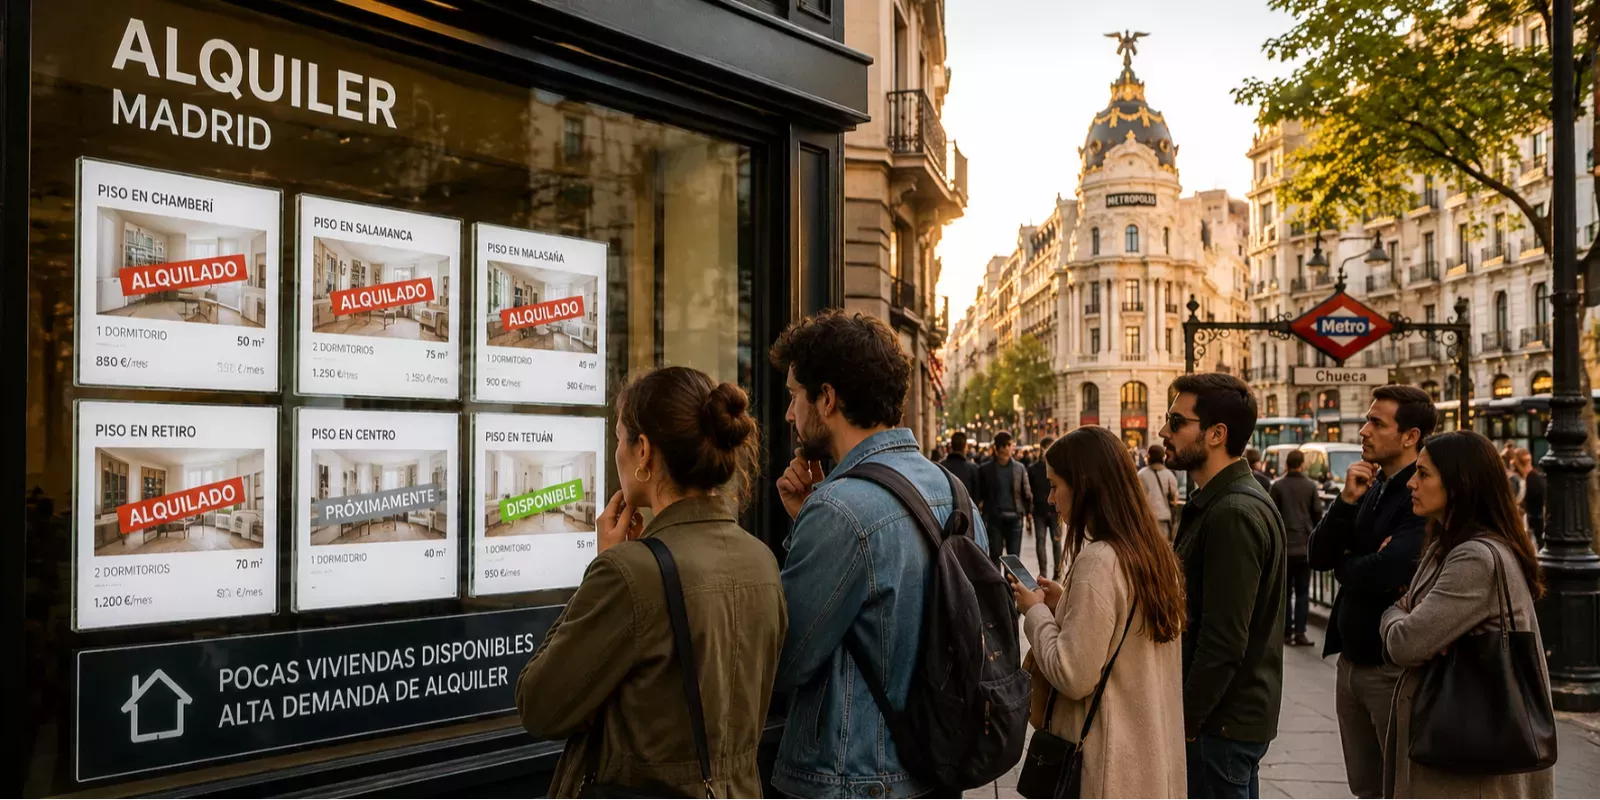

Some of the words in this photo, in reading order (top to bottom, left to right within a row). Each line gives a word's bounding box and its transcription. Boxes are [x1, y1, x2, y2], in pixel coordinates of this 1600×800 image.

[111, 17, 397, 129] ALQUILER
[112, 88, 271, 150] MADRID
[98, 184, 128, 200] PISO
[132, 189, 148, 203] EN
[152, 192, 213, 213] CHAMBERÍ
[1107, 195, 1156, 206] METROPOLIS
[314, 216, 337, 230] PISO
[340, 221, 353, 232] EN
[356, 223, 413, 241] SALAMANCA
[487, 242, 507, 255] PISO
[509, 246, 520, 256] EN
[522, 249, 565, 264] MALASAÑA
[131, 260, 238, 290] ALQUILADO
[341, 283, 427, 311] ALQUILADO
[508, 300, 579, 327] ALQUILADO
[1321, 319, 1366, 333] Metro
[96, 326, 101, 336] 1
[105, 326, 168, 341] DORMITORIO
[237, 336, 249, 347] 50
[312, 342, 318, 351] 2
[320, 343, 374, 355] DORMITORIOS
[426, 349, 436, 359] 75
[486, 354, 490, 362] 1
[491, 354, 533, 365] DORMITORIO
[1315, 370, 1367, 382] Chueca
[95, 424, 126, 437] PISO
[130, 425, 147, 437] EN
[151, 425, 197, 438] RETIRO
[312, 428, 336, 440] PISO
[339, 429, 353, 440] EN
[355, 429, 396, 440] CENTRO
[485, 431, 505, 442] PISO
[508, 432, 519, 442] EN
[521, 430, 553, 442] TETUÁN
[129, 484, 236, 527] ALQUILADO
[325, 488, 435, 520] PRÓXIMAMENTE
[506, 484, 577, 517] DISPONIBLE
[424, 548, 434, 558] 40
[485, 545, 489, 554] 1
[490, 543, 531, 554] DORMITORIO
[236, 559, 248, 569] 70
[310, 555, 315, 565] 1
[94, 567, 101, 578] 2
[103, 564, 170, 578] DORMITORIOS
[484, 569, 499, 578] 950
[94, 596, 122, 608] 1.200
[124, 595, 153, 607] €/mes
[219, 660, 300, 692] POCAS
[306, 647, 415, 681] VIVIENDAS
[422, 632, 534, 667] DISPONIBLES
[218, 698, 275, 728] ALTA
[282, 682, 389, 719] DEMANDA
[395, 678, 420, 702] DE
[425, 665, 509, 697] ALQUILER
